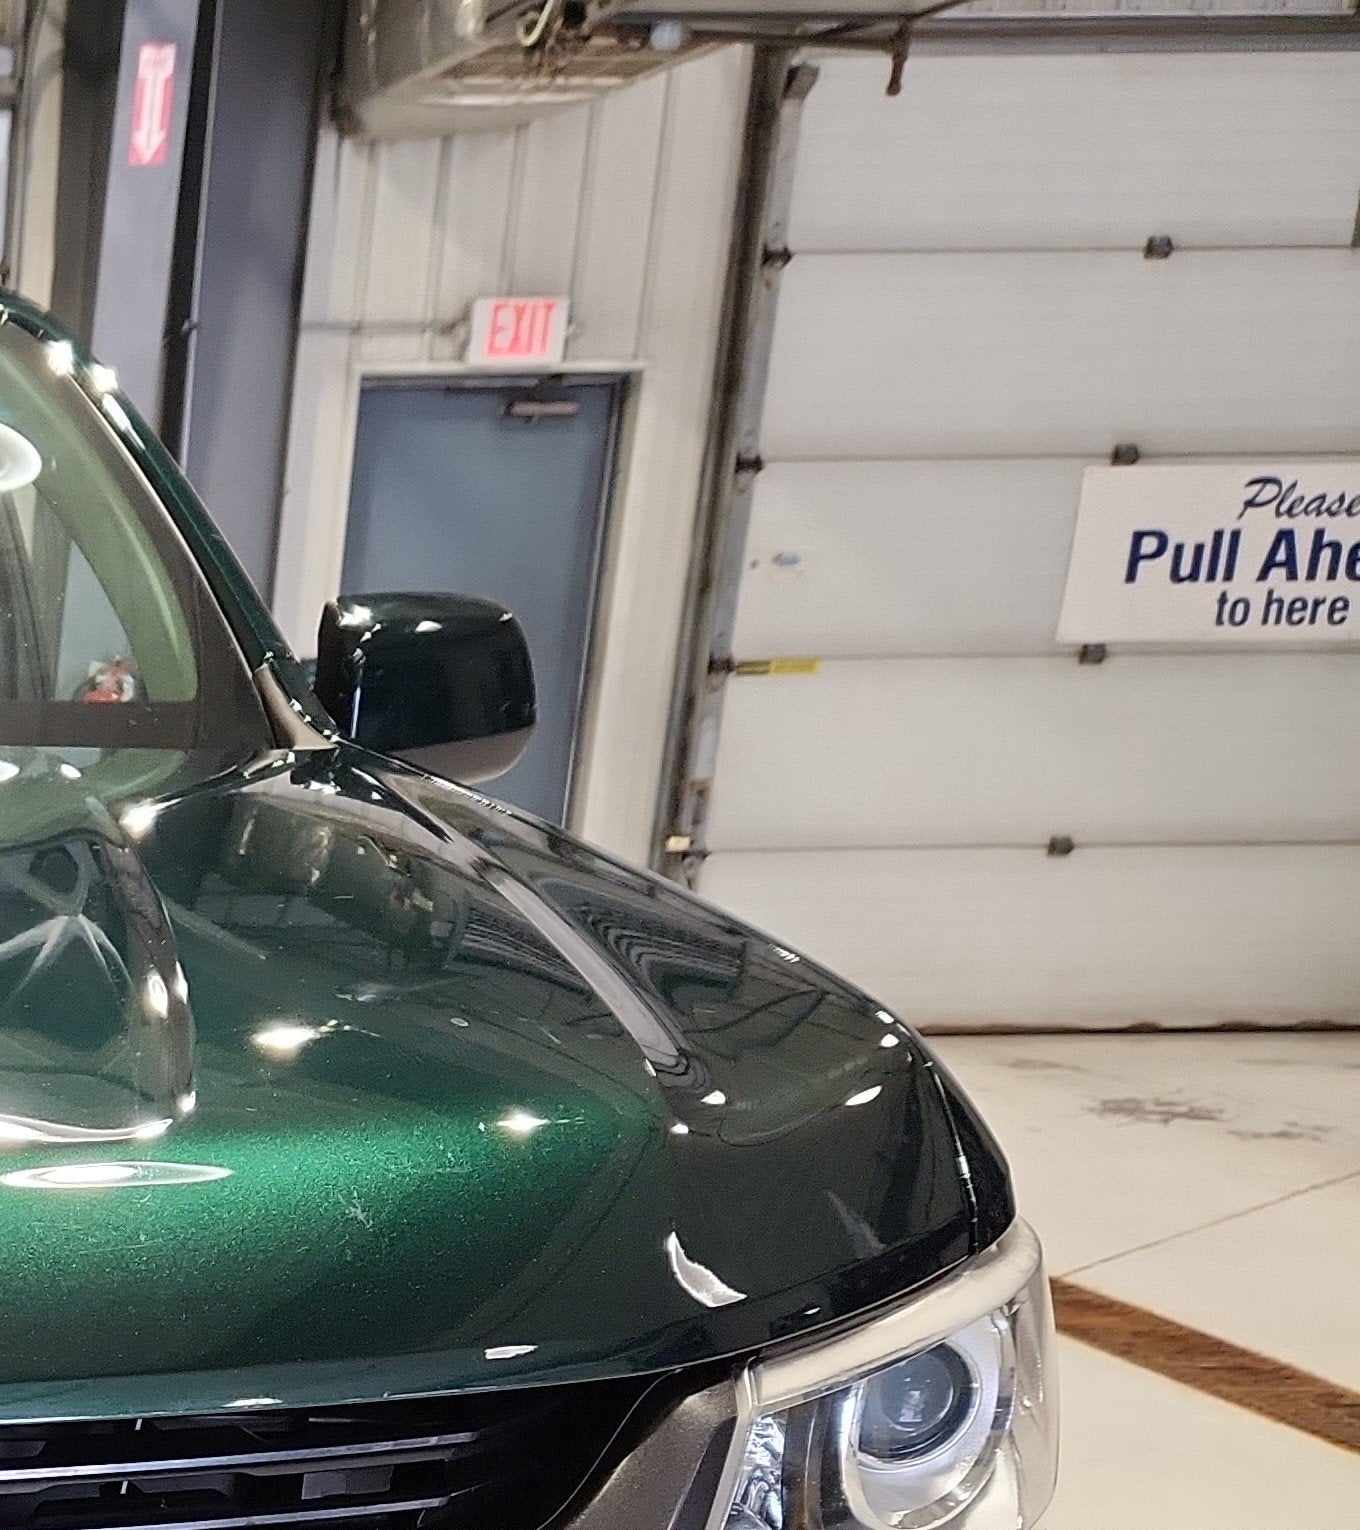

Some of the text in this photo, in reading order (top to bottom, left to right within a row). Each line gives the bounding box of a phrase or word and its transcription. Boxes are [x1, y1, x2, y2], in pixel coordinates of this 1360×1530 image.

[486, 300, 554, 355] EXIT
[1124, 528, 1242, 585] Pull
[1215, 587, 1351, 627] to here
